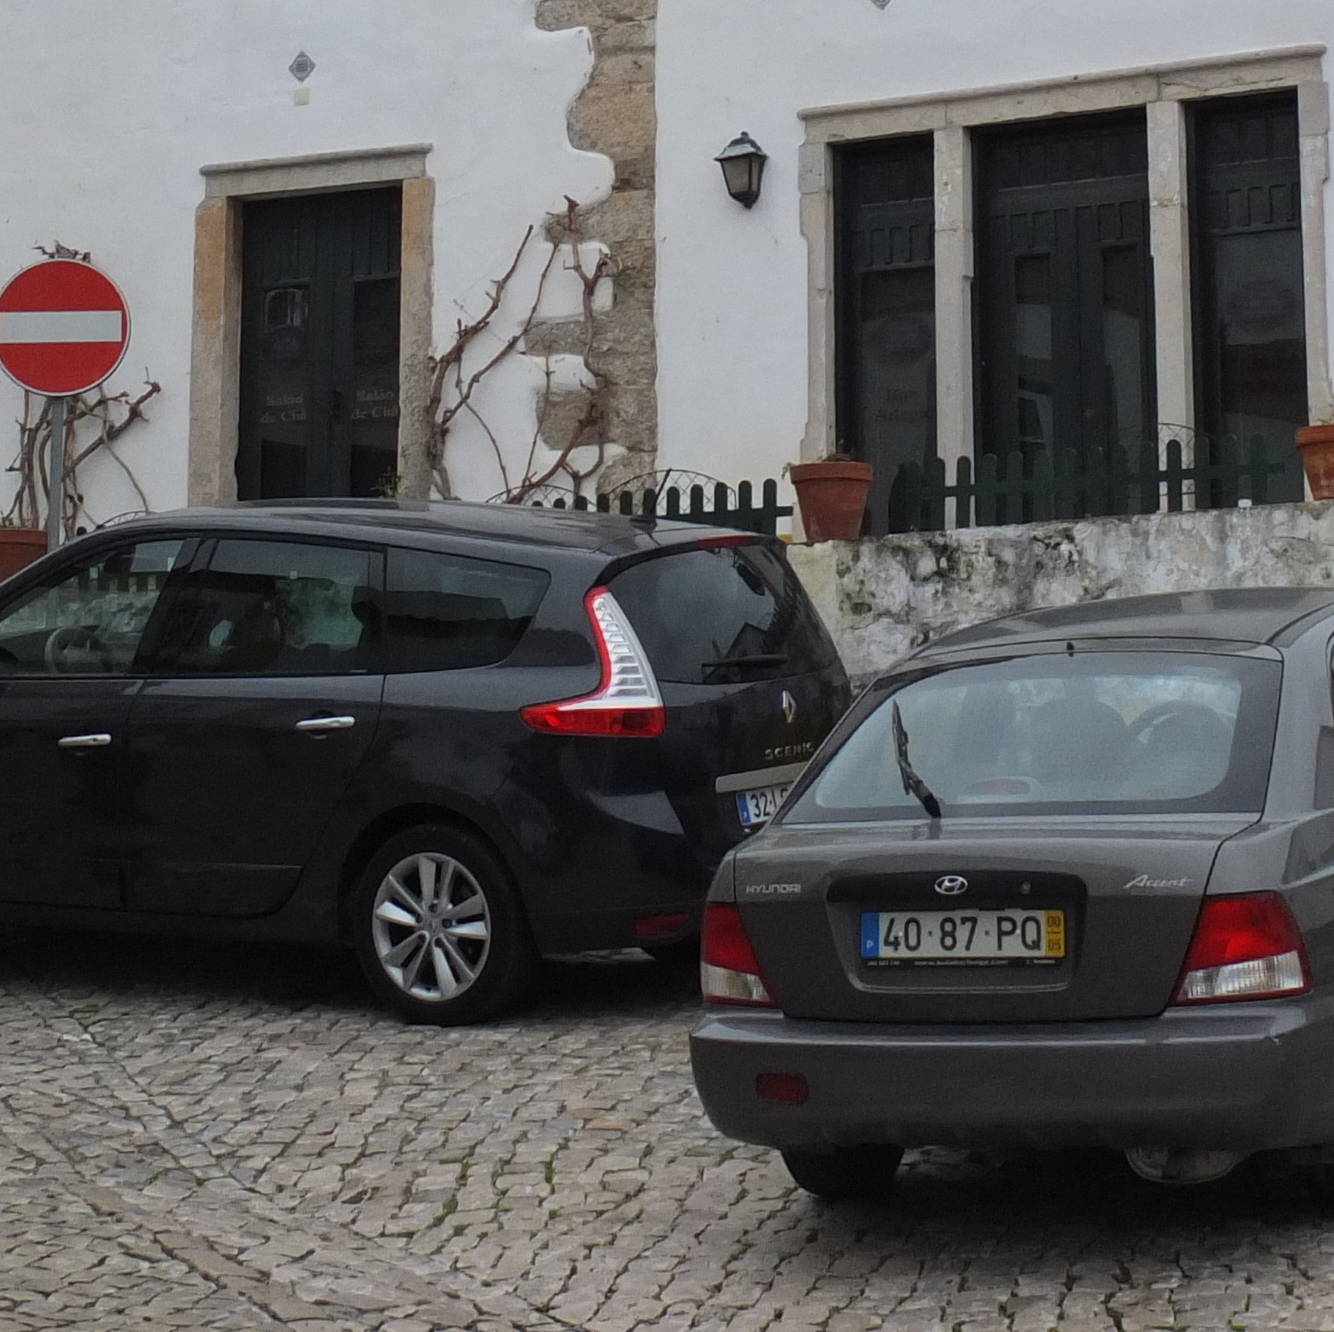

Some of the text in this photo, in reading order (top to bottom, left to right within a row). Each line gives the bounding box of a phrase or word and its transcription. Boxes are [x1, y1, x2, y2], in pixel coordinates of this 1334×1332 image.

[764, 741, 814, 761] SCENIC
[746, 884, 802, 894] HYUNDAI
[1123, 874, 1194, 889] Accent
